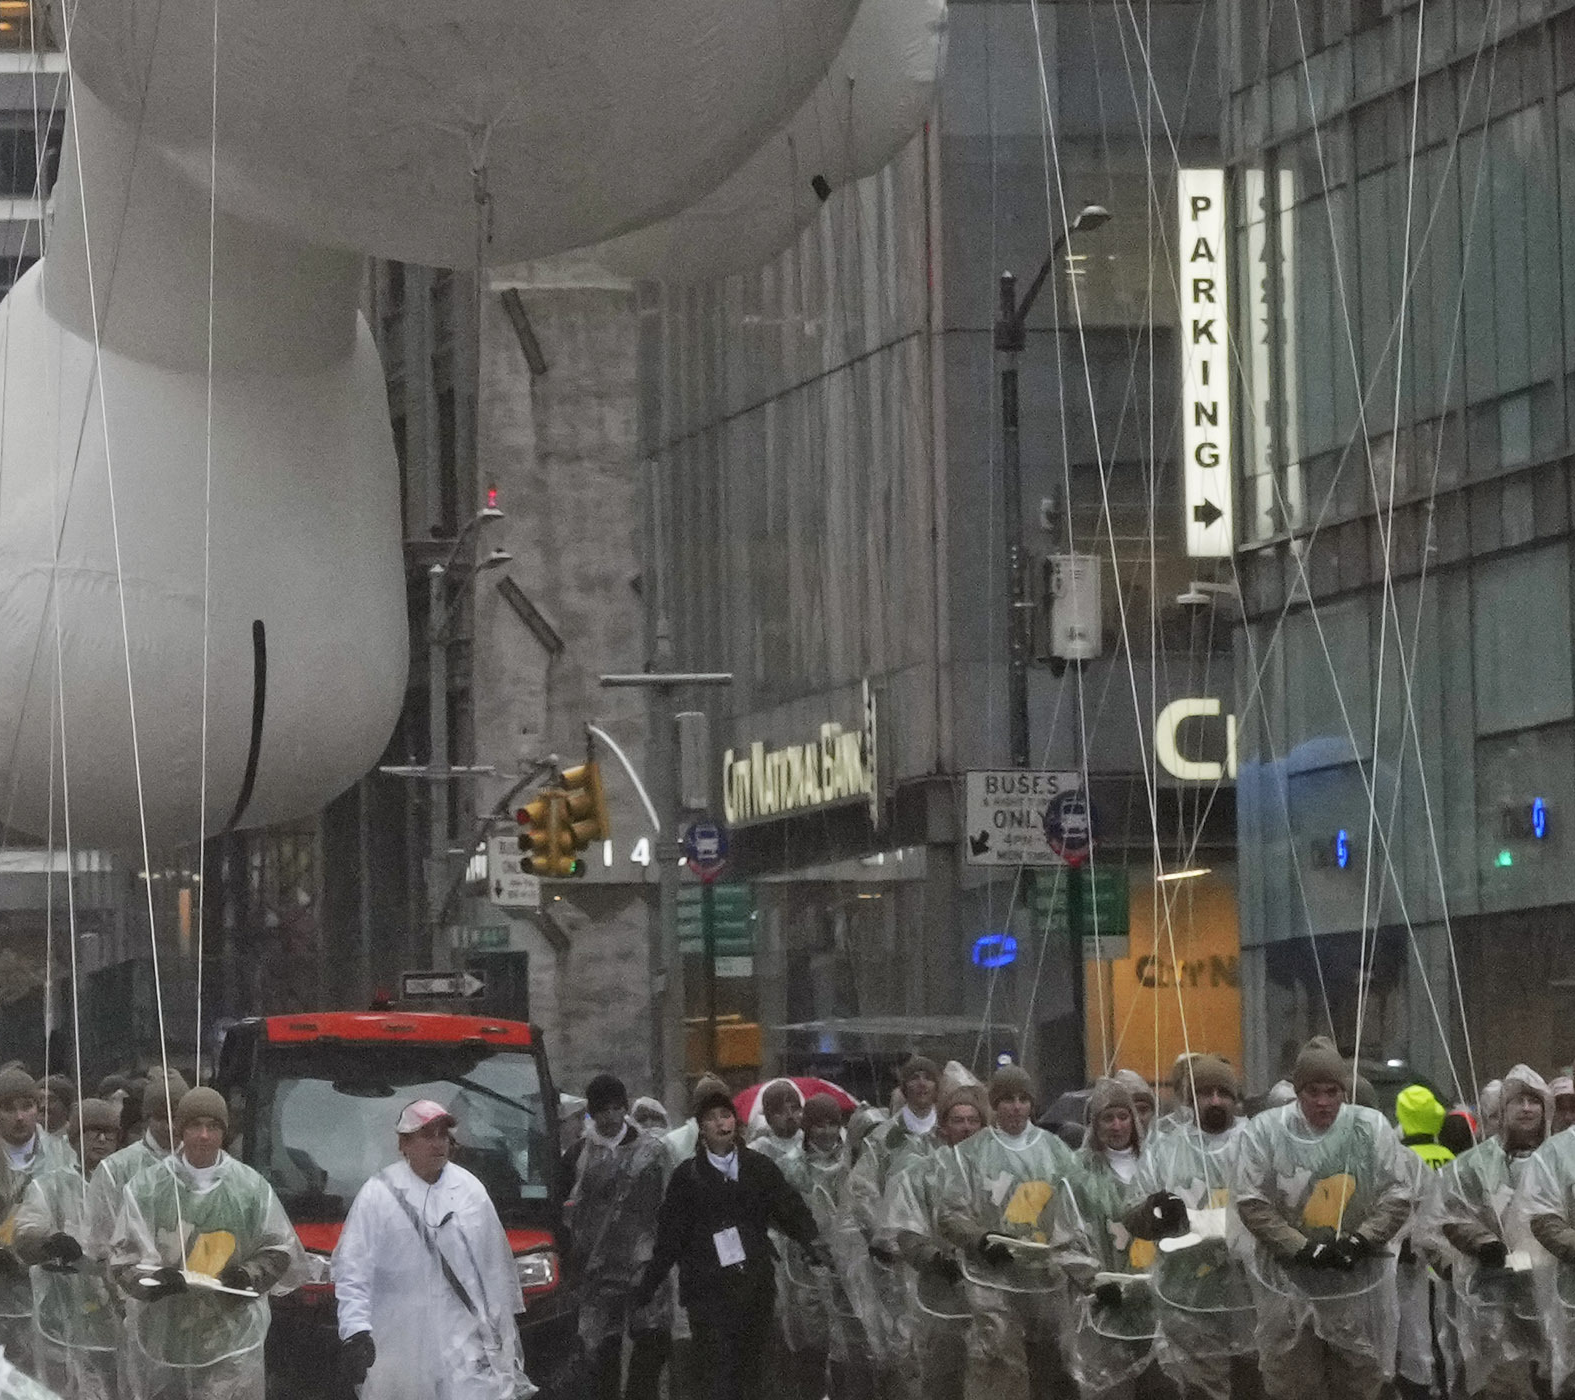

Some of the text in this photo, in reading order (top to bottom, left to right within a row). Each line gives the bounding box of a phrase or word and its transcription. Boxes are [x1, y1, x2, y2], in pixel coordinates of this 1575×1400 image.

[1190, 196, 1220, 468] PARKING
[751, 740, 822, 816] NATIONAL
[821, 721, 872, 802] BANK
[985, 774, 1060, 795] BUSES
